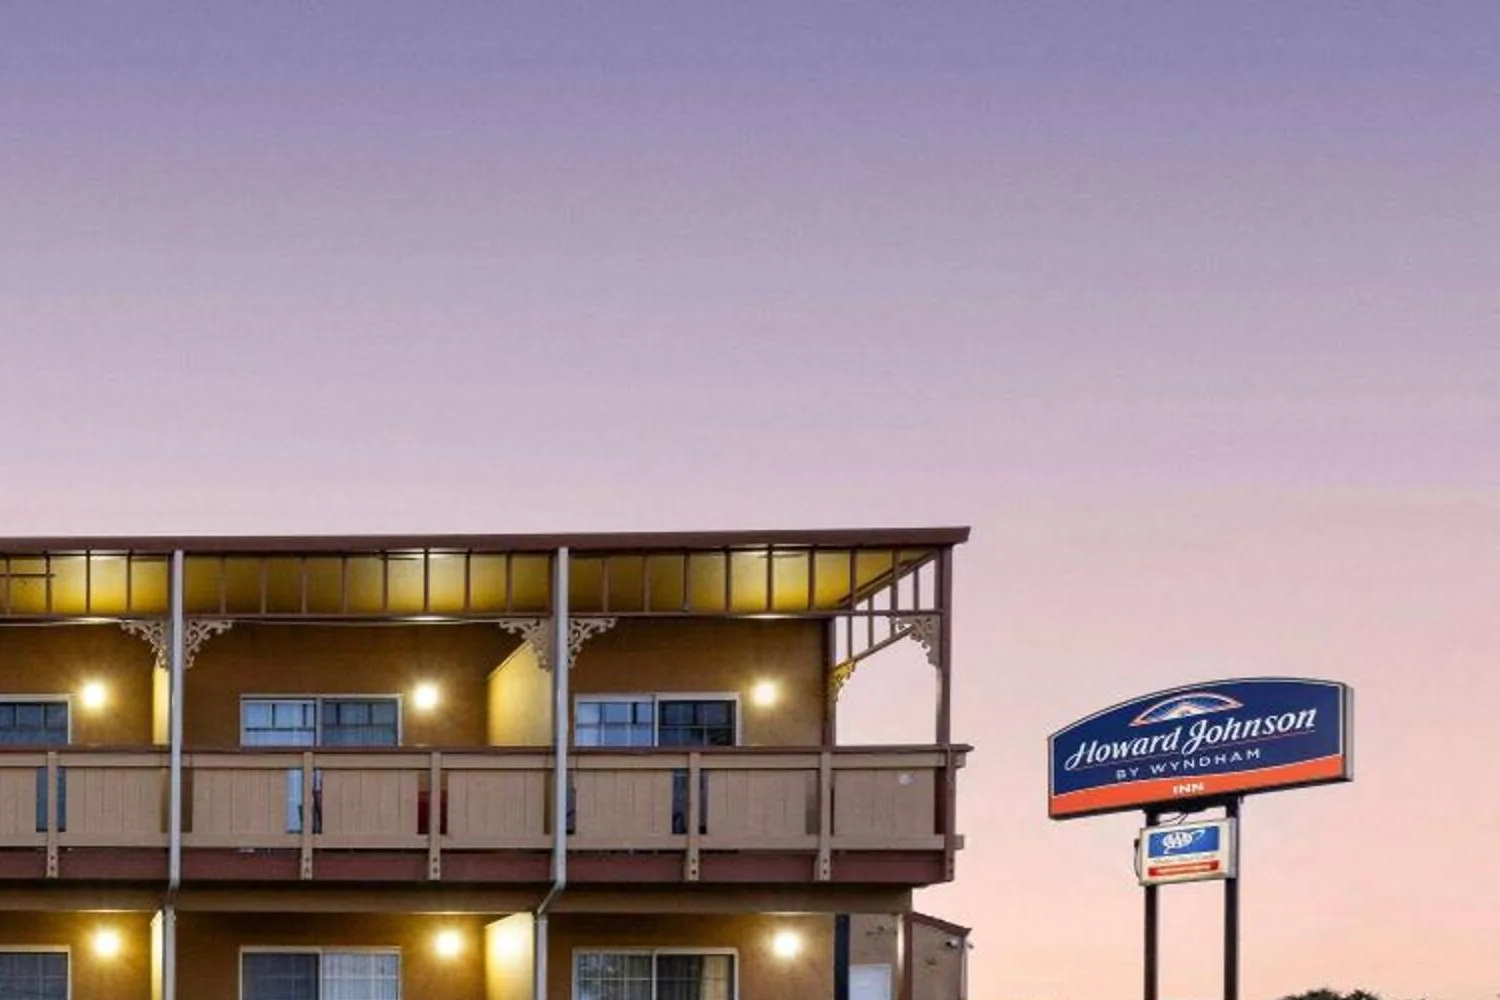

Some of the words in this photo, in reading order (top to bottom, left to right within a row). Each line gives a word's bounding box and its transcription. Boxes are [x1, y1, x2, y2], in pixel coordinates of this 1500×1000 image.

[1064, 726, 1182, 771] Howard
[1181, 708, 1317, 756] Johnson
[1115, 767, 1139, 780] BY
[1149, 748, 1261, 775] WYNDHAM
[1172, 782, 1205, 795] INN
